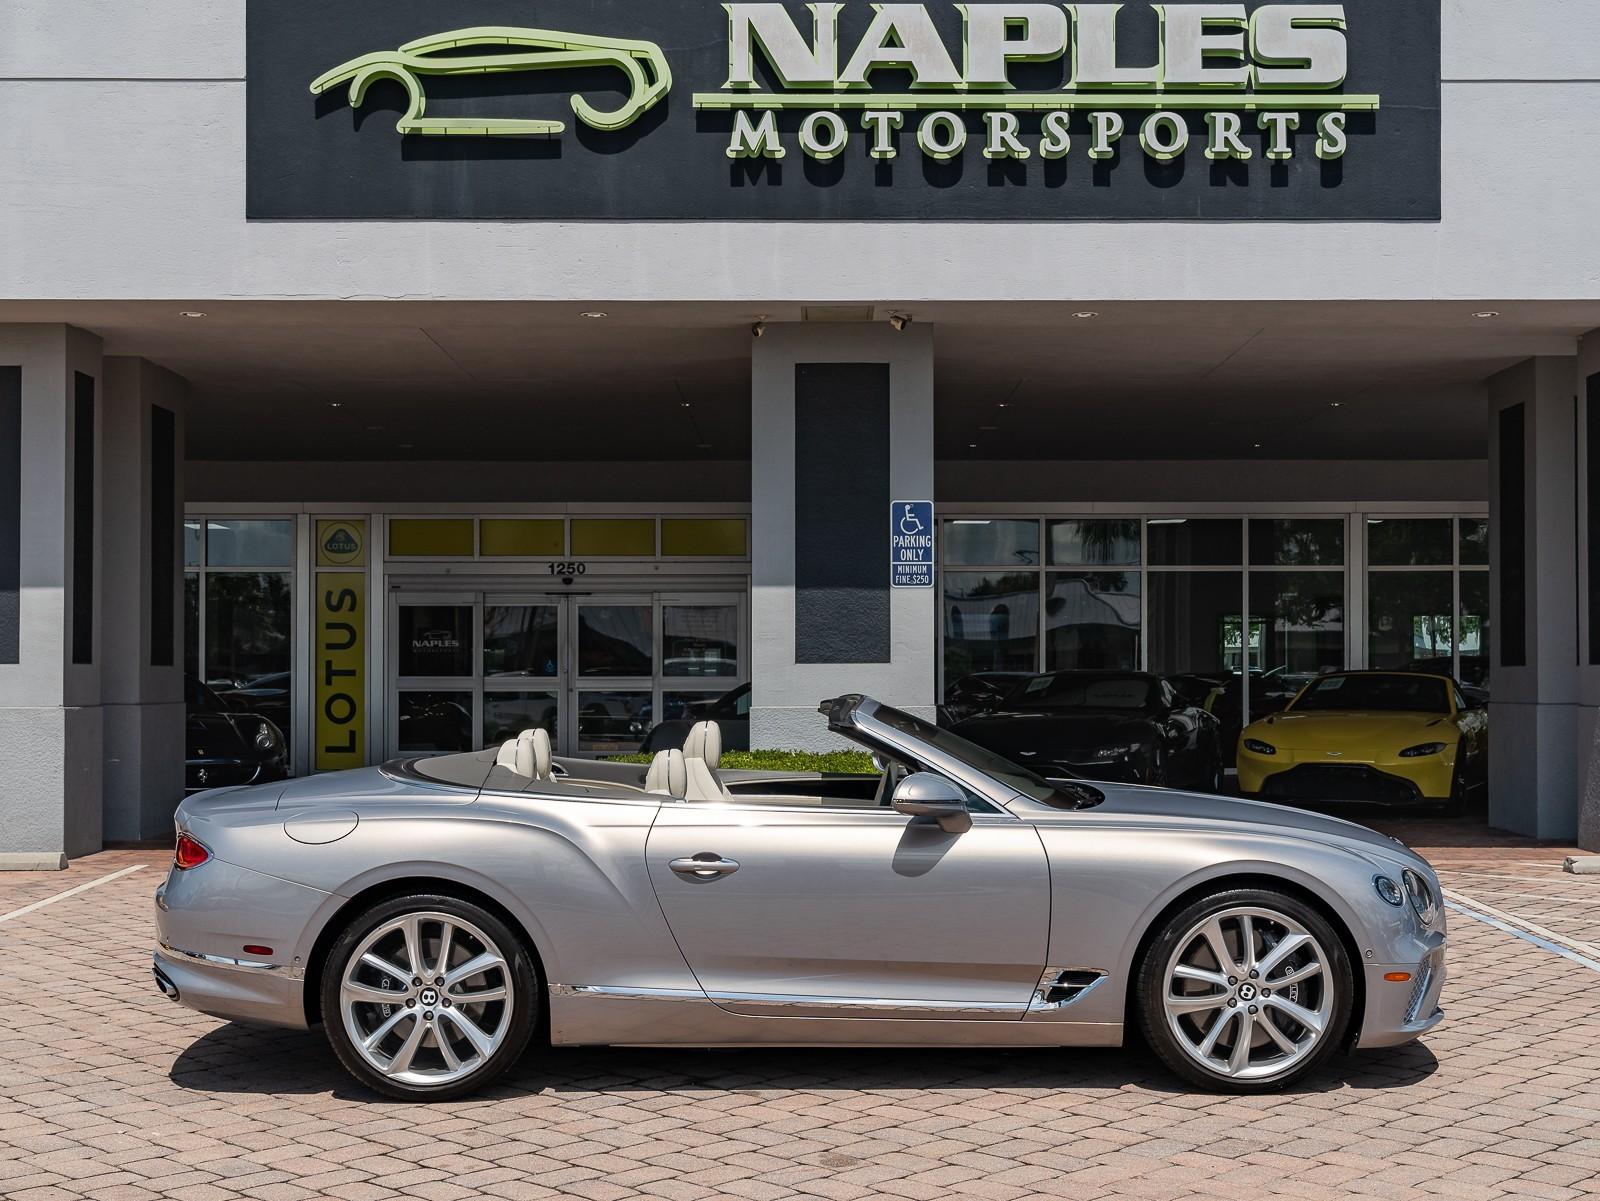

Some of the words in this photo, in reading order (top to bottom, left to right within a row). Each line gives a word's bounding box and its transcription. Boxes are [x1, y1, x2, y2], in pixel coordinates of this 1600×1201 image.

[721, 3, 1348, 90] NAPLES
[726, 110, 1347, 160] MOTORSPORTS
[893, 535, 931, 548] PARKING
[900, 549, 924, 561] ONLY
[548, 561, 586, 576] 1250
[897, 565, 927, 574] MINIMUM
[895, 575, 911, 584] FINE
[912, 574, 929, 585] $250
[325, 588, 357, 753] LOTUS
